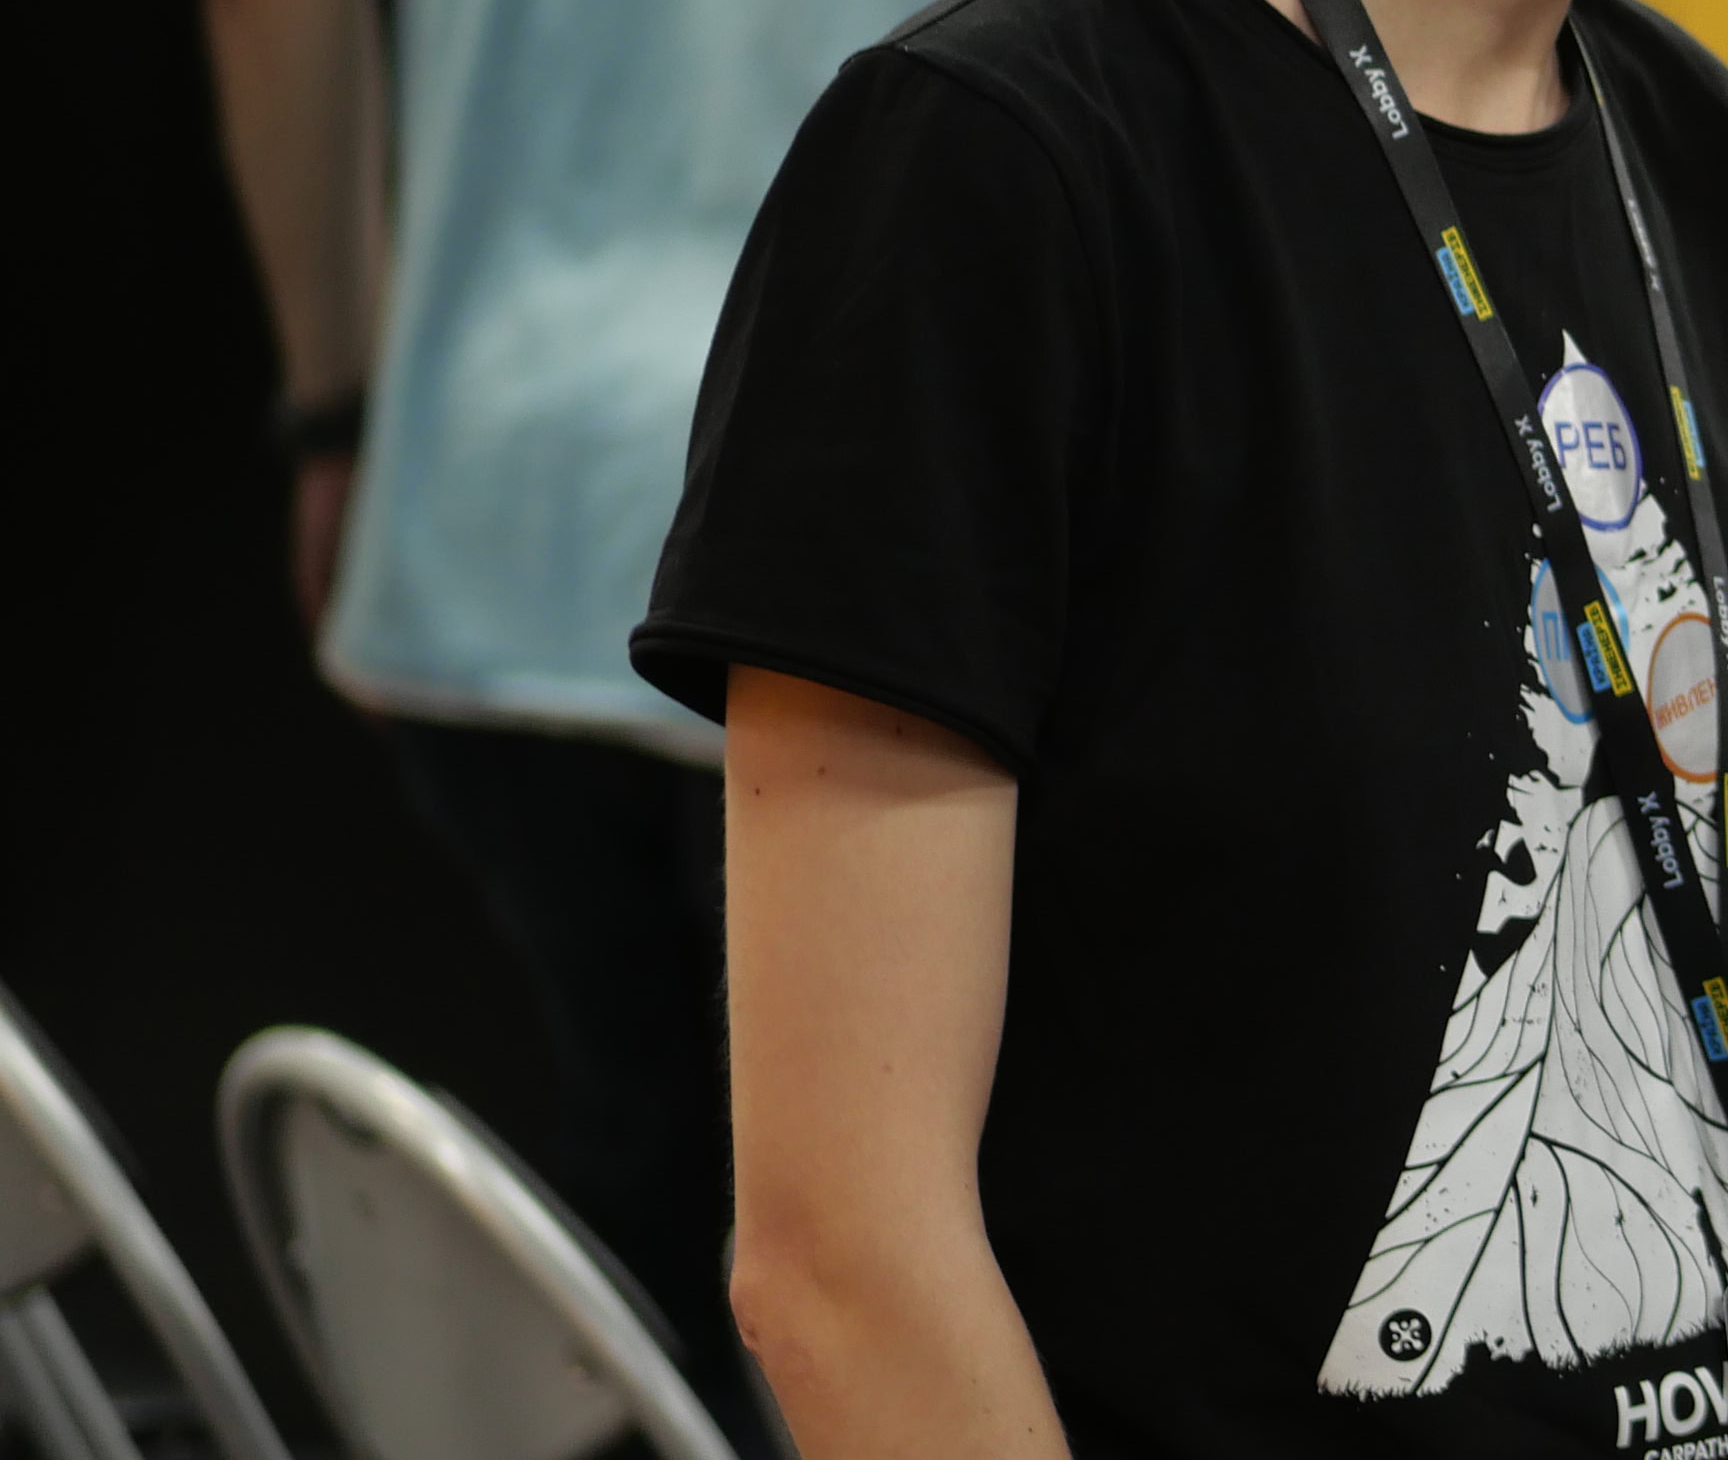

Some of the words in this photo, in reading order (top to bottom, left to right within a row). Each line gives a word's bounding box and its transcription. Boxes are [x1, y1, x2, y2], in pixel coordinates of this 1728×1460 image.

[1349, 44, 1373, 68] X
[1365, 68, 1409, 140] Lobby
[1513, 414, 1534, 438] X
[1554, 419, 1627, 471] РЕБ
[1526, 437, 1563, 513] Lobby
[1637, 790, 1661, 814] X
[1649, 816, 1684, 889] Lobby
